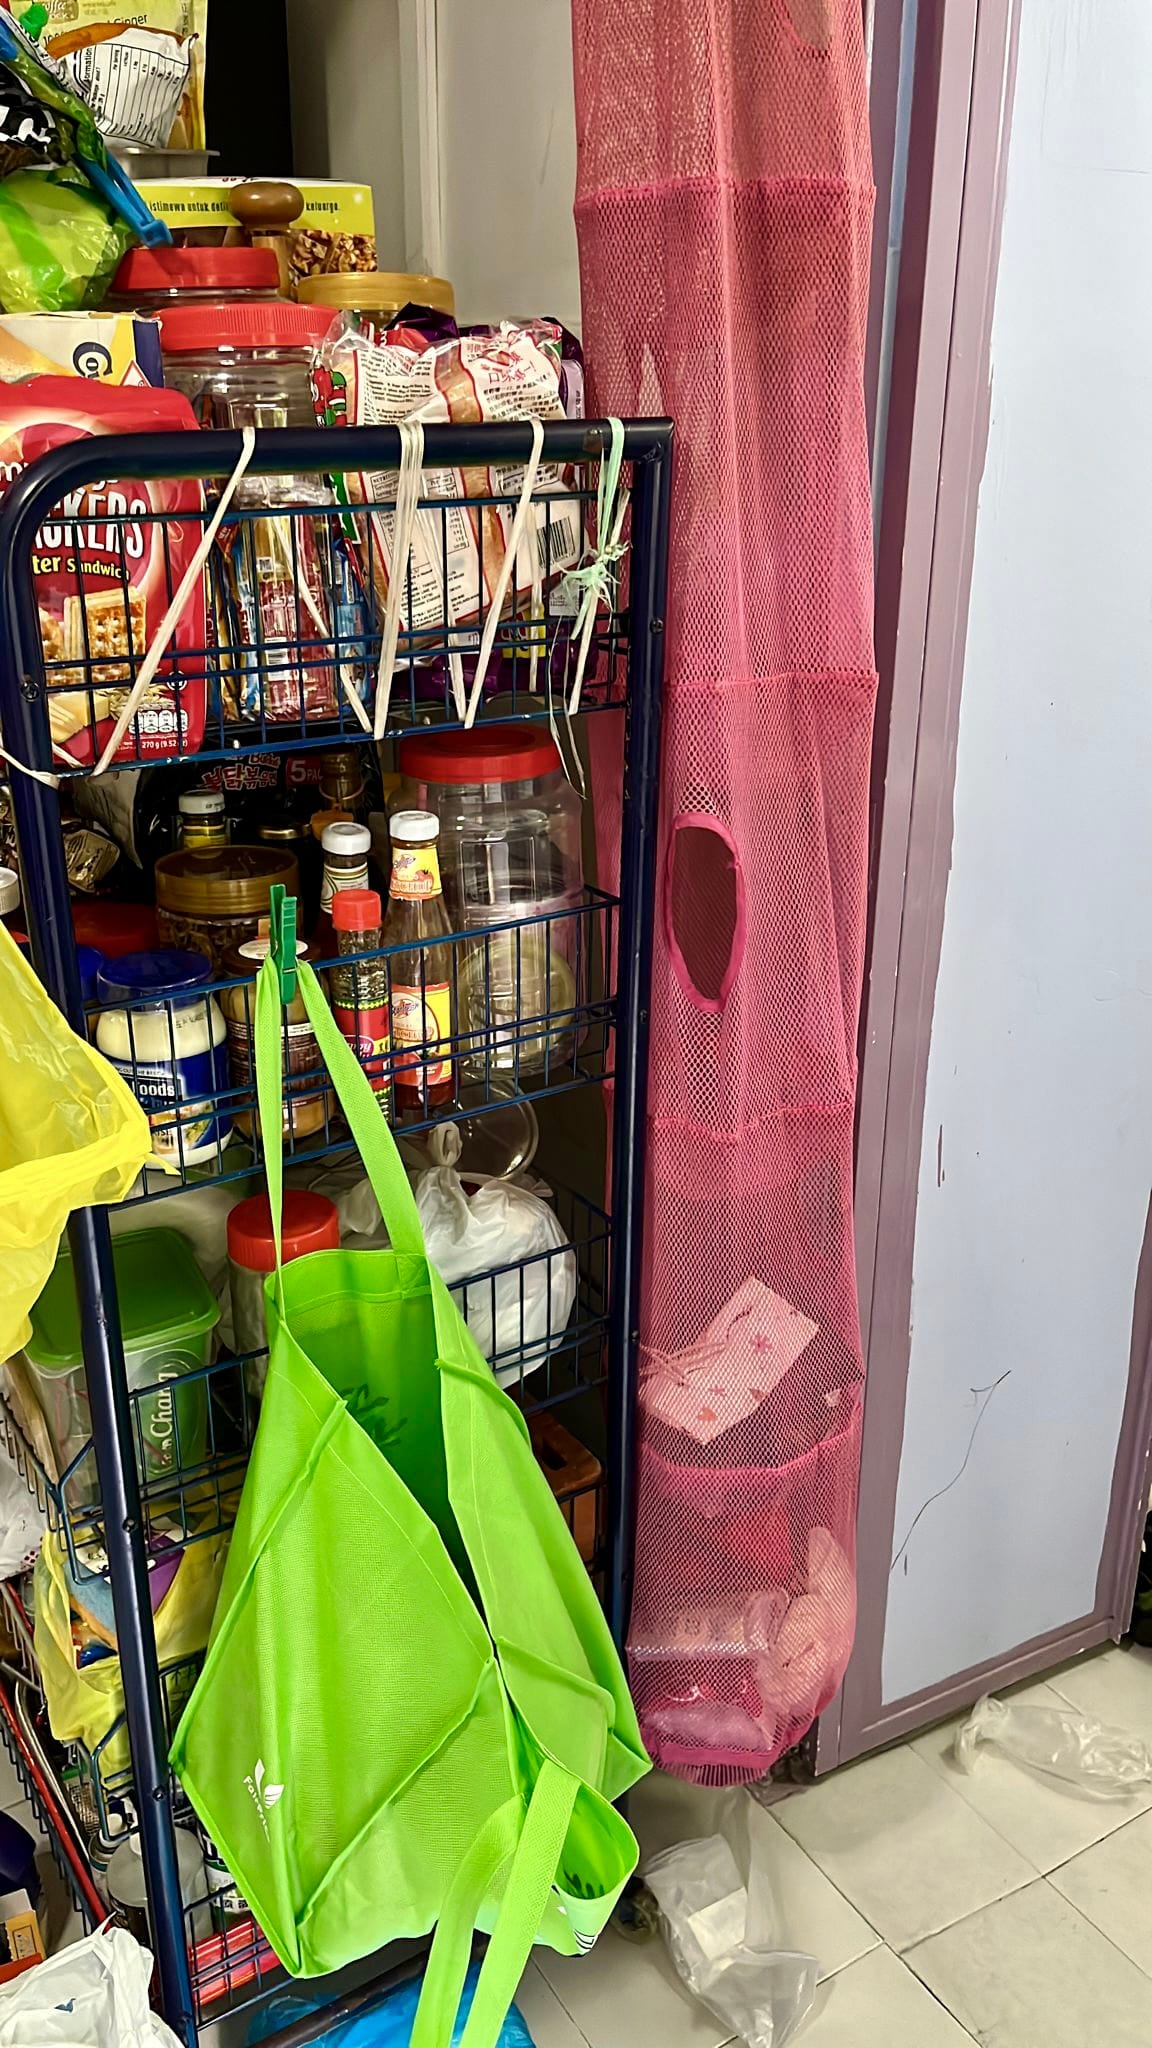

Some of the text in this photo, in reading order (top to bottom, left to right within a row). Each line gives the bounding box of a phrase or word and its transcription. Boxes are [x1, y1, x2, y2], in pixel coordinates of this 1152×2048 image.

[35, 488, 148, 559] CKERS
[32, 555, 130, 581] ter sndwic
[142, 741, 155, 749] 270
[290, 760, 324, 783] 5 PAC
